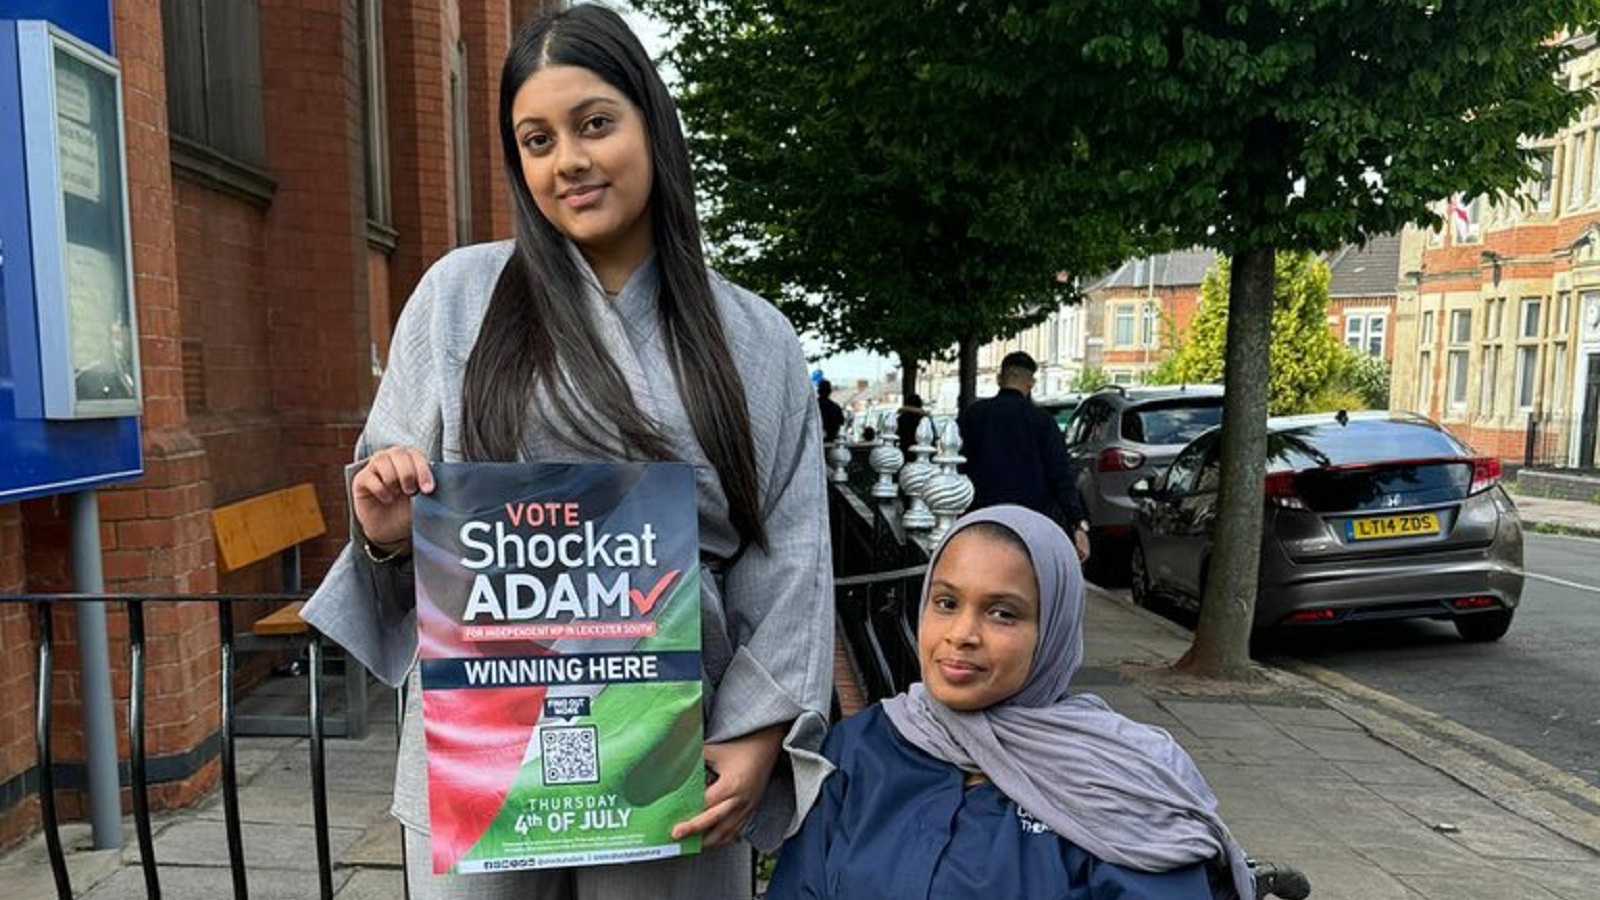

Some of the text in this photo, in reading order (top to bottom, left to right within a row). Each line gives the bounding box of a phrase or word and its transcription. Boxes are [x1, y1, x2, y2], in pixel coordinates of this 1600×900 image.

[505, 502, 580, 527] VOTE
[1359, 515, 1432, 536] LT14 ZDS
[459, 520, 657, 568] Shockat
[462, 572, 631, 621] ADAM
[466, 628, 484, 638] FOR
[485, 626, 549, 637] INDEPENDENT
[576, 624, 622, 635] LEICESTER
[623, 623, 653, 634] SOUTH
[464, 655, 658, 685] WINNING HERE
[528, 794, 618, 811] THURSDAY
[513, 807, 632, 836] 4th OF JULY
